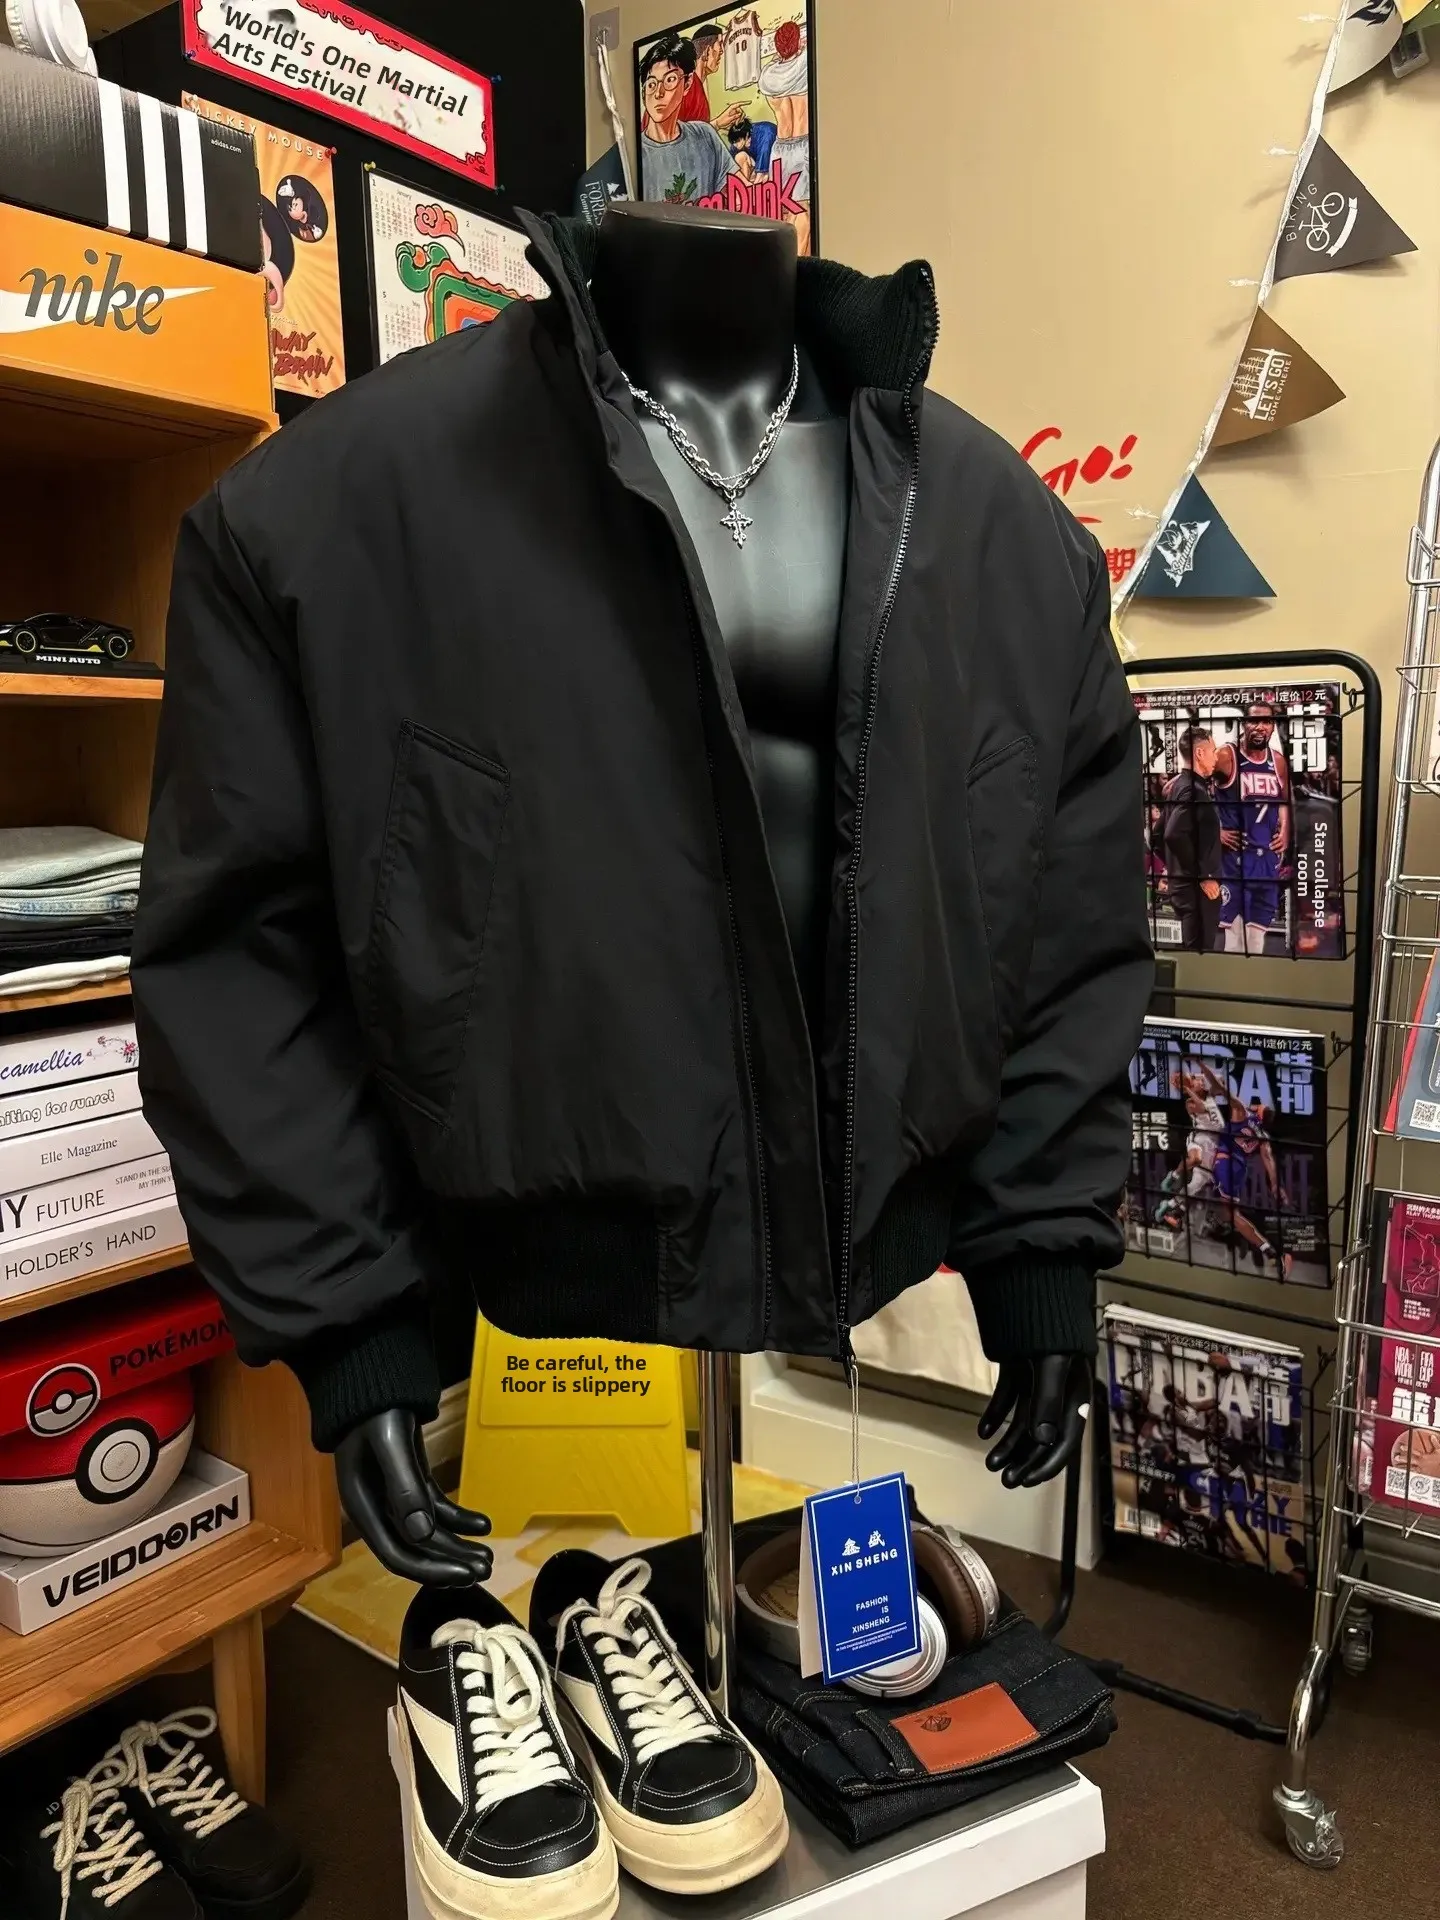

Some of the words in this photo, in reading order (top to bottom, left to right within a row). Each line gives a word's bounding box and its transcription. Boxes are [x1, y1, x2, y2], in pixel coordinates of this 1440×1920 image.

[225, 6, 315, 57] World's
[322, 45, 371, 79] One
[377, 66, 469, 117] Martial
[735, 39, 748, 55] 10
[212, 33, 265, 67] Arts
[270, 53, 367, 107] Festival
[190, 104, 257, 135] MICKEY
[268, 130, 324, 161] MOUSE
[210, 138, 242, 154] adidas.com
[1285, 183, 1318, 242] BIKING
[20, 249, 165, 335] nike
[1254, 379, 1278, 421] LET'S
[1268, 358, 1285, 378] GO
[1268, 360, 1292, 422] SOMEWHERE
[36, 655, 67, 663] MINI
[68, 656, 101, 665] AUTO
[1279, 689, 1327, 703] 定价12元
[1240, 772, 1279, 799] NETS
[1255, 800, 1268, 824] 7
[1314, 822, 1328, 855] Star
[1297, 853, 1308, 897] room
[1313, 857, 1328, 928] collapse
[0, 1049, 85, 1080] camellia
[45, 1102, 68, 1117] for
[70, 1088, 115, 1112] sunset
[40, 1151, 63, 1166] Elle
[66, 1139, 118, 1159] Magazine
[115, 1172, 139, 1186] STAND
[139, 1170, 147, 1179] IN
[148, 1167, 161, 1177] THE
[138, 1180, 149, 1190] MY
[36, 1189, 106, 1222] FUTURE
[5, 1241, 94, 1280] HOLDER'S
[107, 1225, 156, 1251] HAND
[507, 1355, 530, 1371] Be
[535, 1355, 609, 1374] careful,
[615, 1355, 647, 1371] the
[501, 1377, 546, 1393] floor
[552, 1377, 566, 1393] is
[572, 1377, 651, 1397] slippery
[42, 1496, 239, 1608] VEIDOORN
[831, 1562, 853, 1577] XIN
[855, 1548, 898, 1570] SHENG
[856, 1595, 889, 1612] FASHION
[881, 1605, 889, 1614] IS
[852, 1615, 890, 1634] XINSHENG
